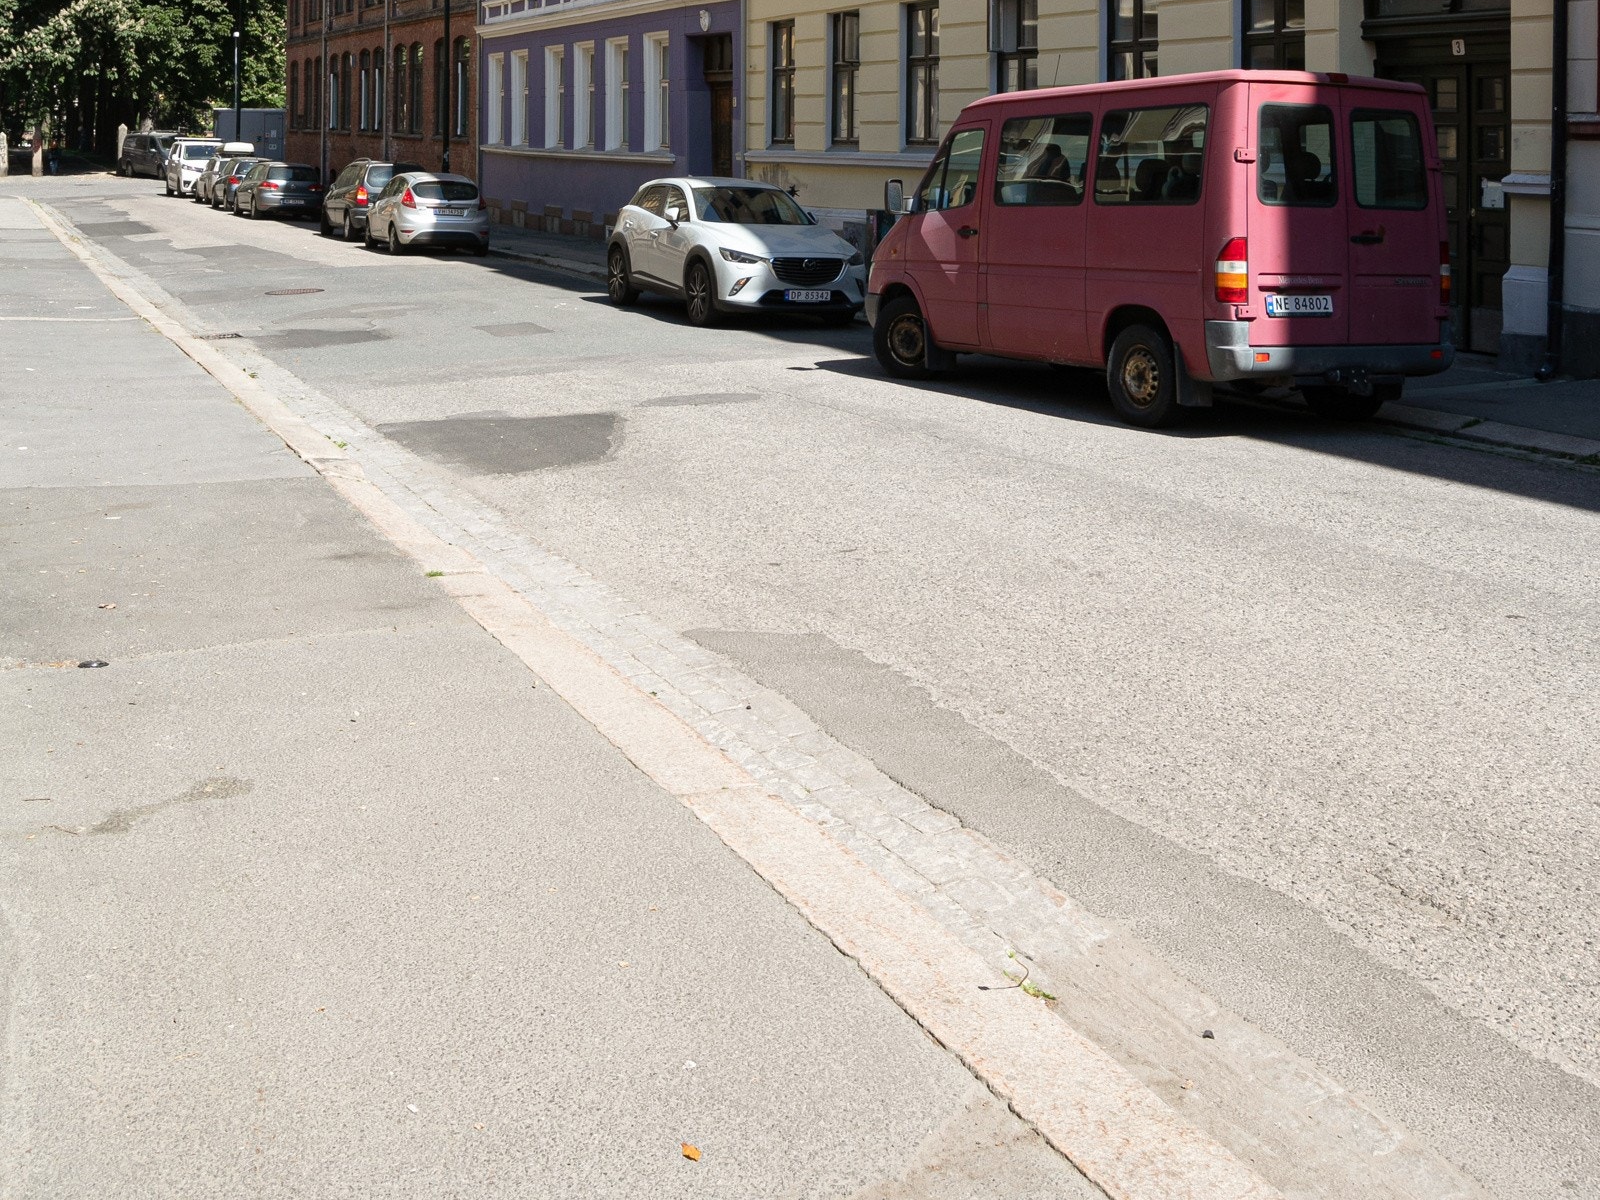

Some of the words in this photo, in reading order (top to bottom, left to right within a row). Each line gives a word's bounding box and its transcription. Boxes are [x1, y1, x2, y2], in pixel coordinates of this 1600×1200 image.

[1455, 41, 1461, 53] 3
[791, 291, 801, 300] DP
[804, 291, 829, 300] 85342
[1275, 297, 1290, 311] NE
[1294, 297, 1329, 311] 84802
